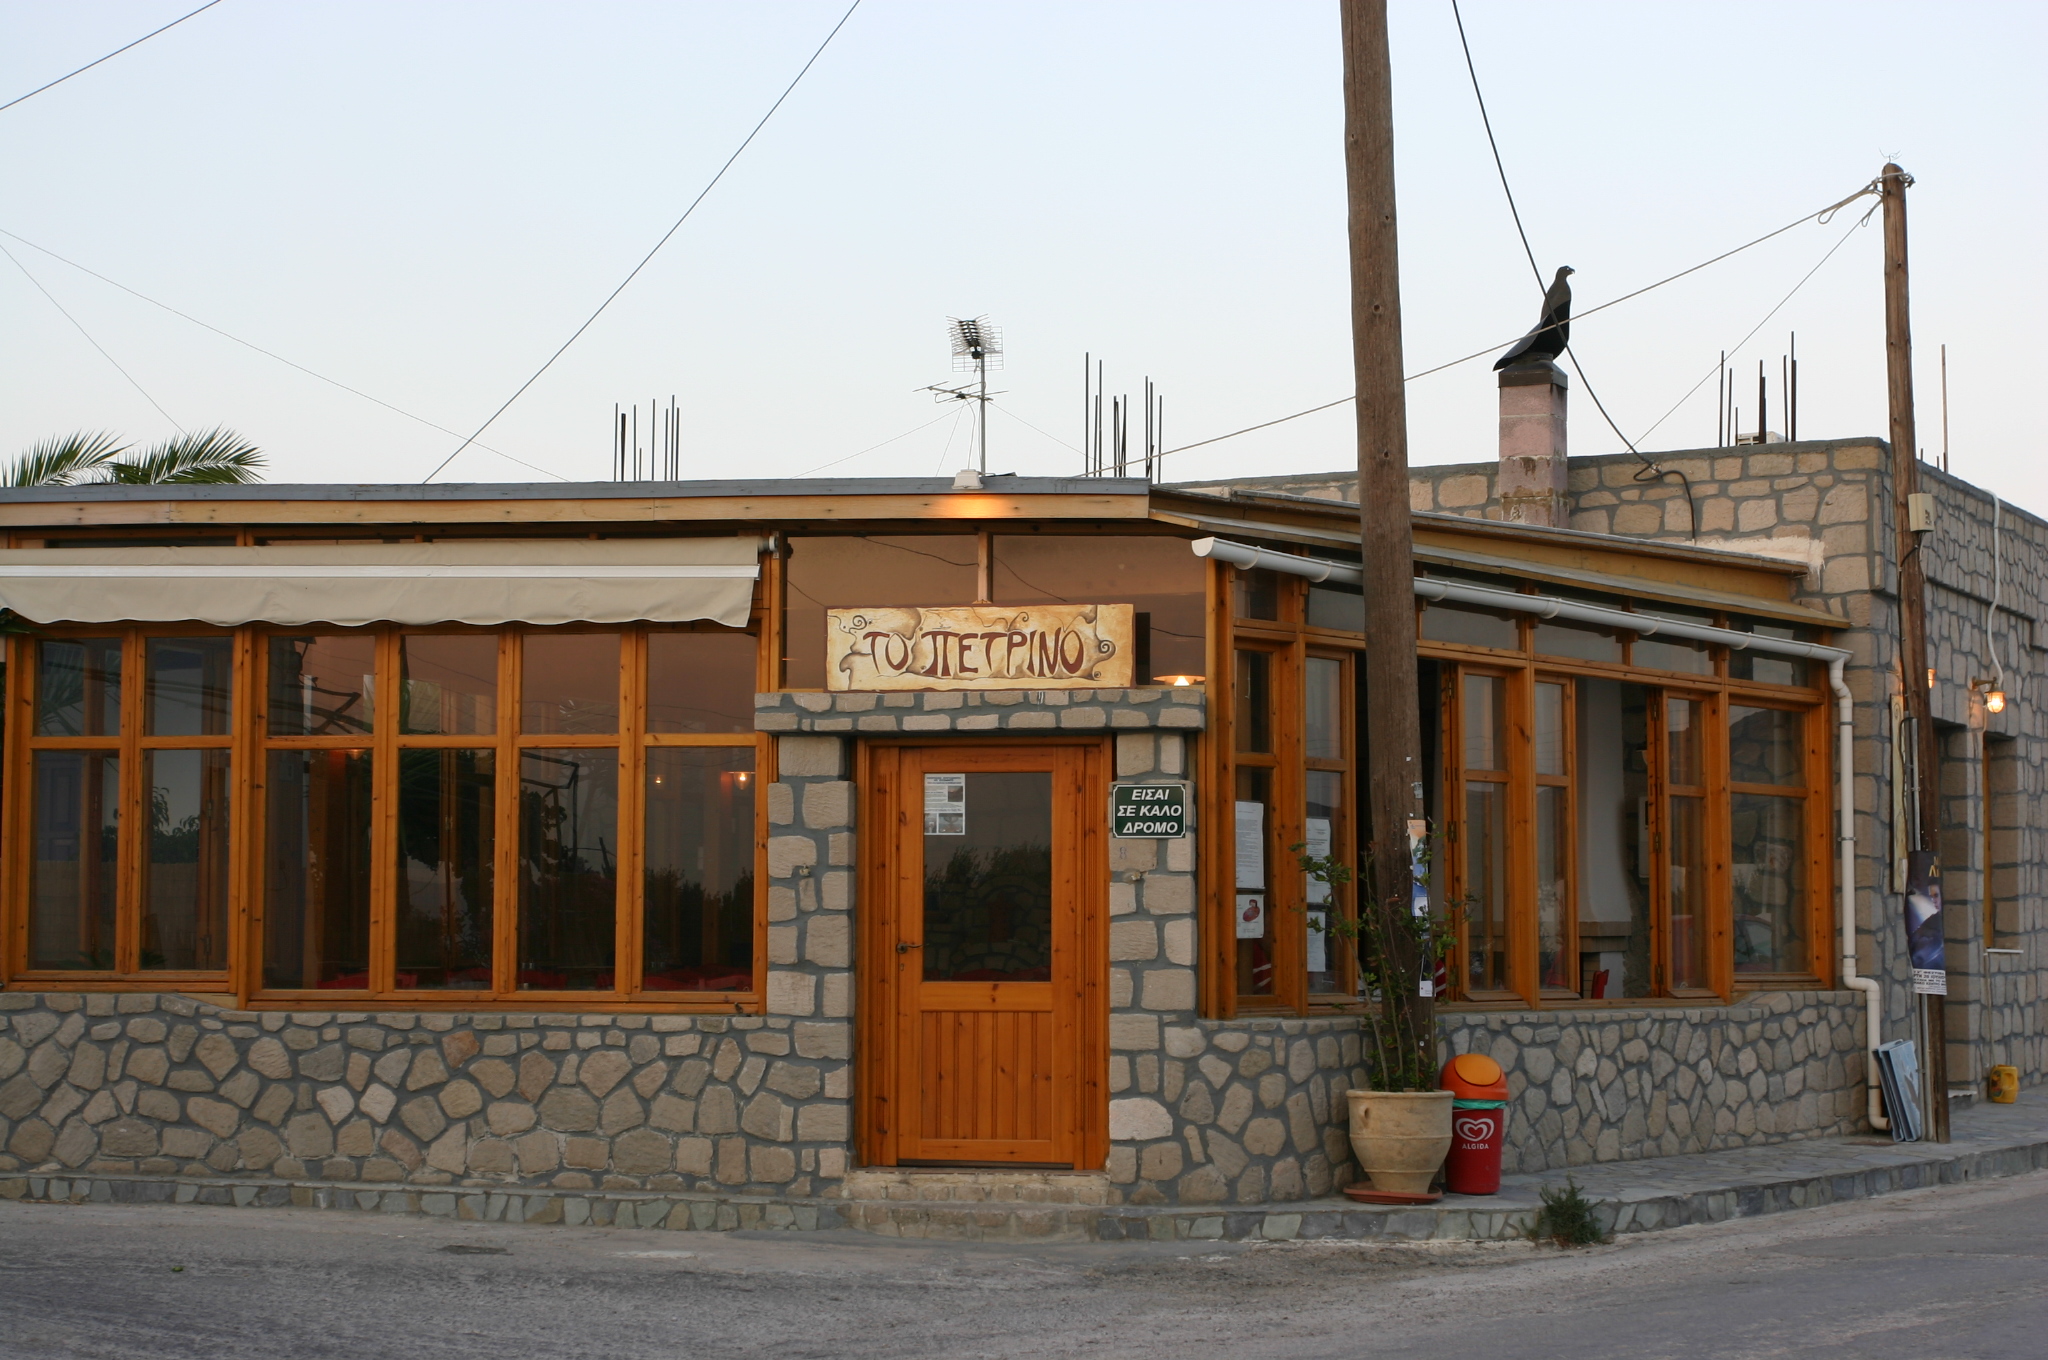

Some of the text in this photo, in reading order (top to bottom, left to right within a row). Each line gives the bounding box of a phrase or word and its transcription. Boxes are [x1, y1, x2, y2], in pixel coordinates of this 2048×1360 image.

[863, 627, 1084, 677] ΤΟ ΠΕΤΡΙΝΟ
[1131, 788, 1170, 801] ΕΙΣΑΙ
[1117, 804, 1182, 817] ΣΕ ΚΑΛΟ
[1122, 821, 1178, 834] ΔΡΟΜΟ
